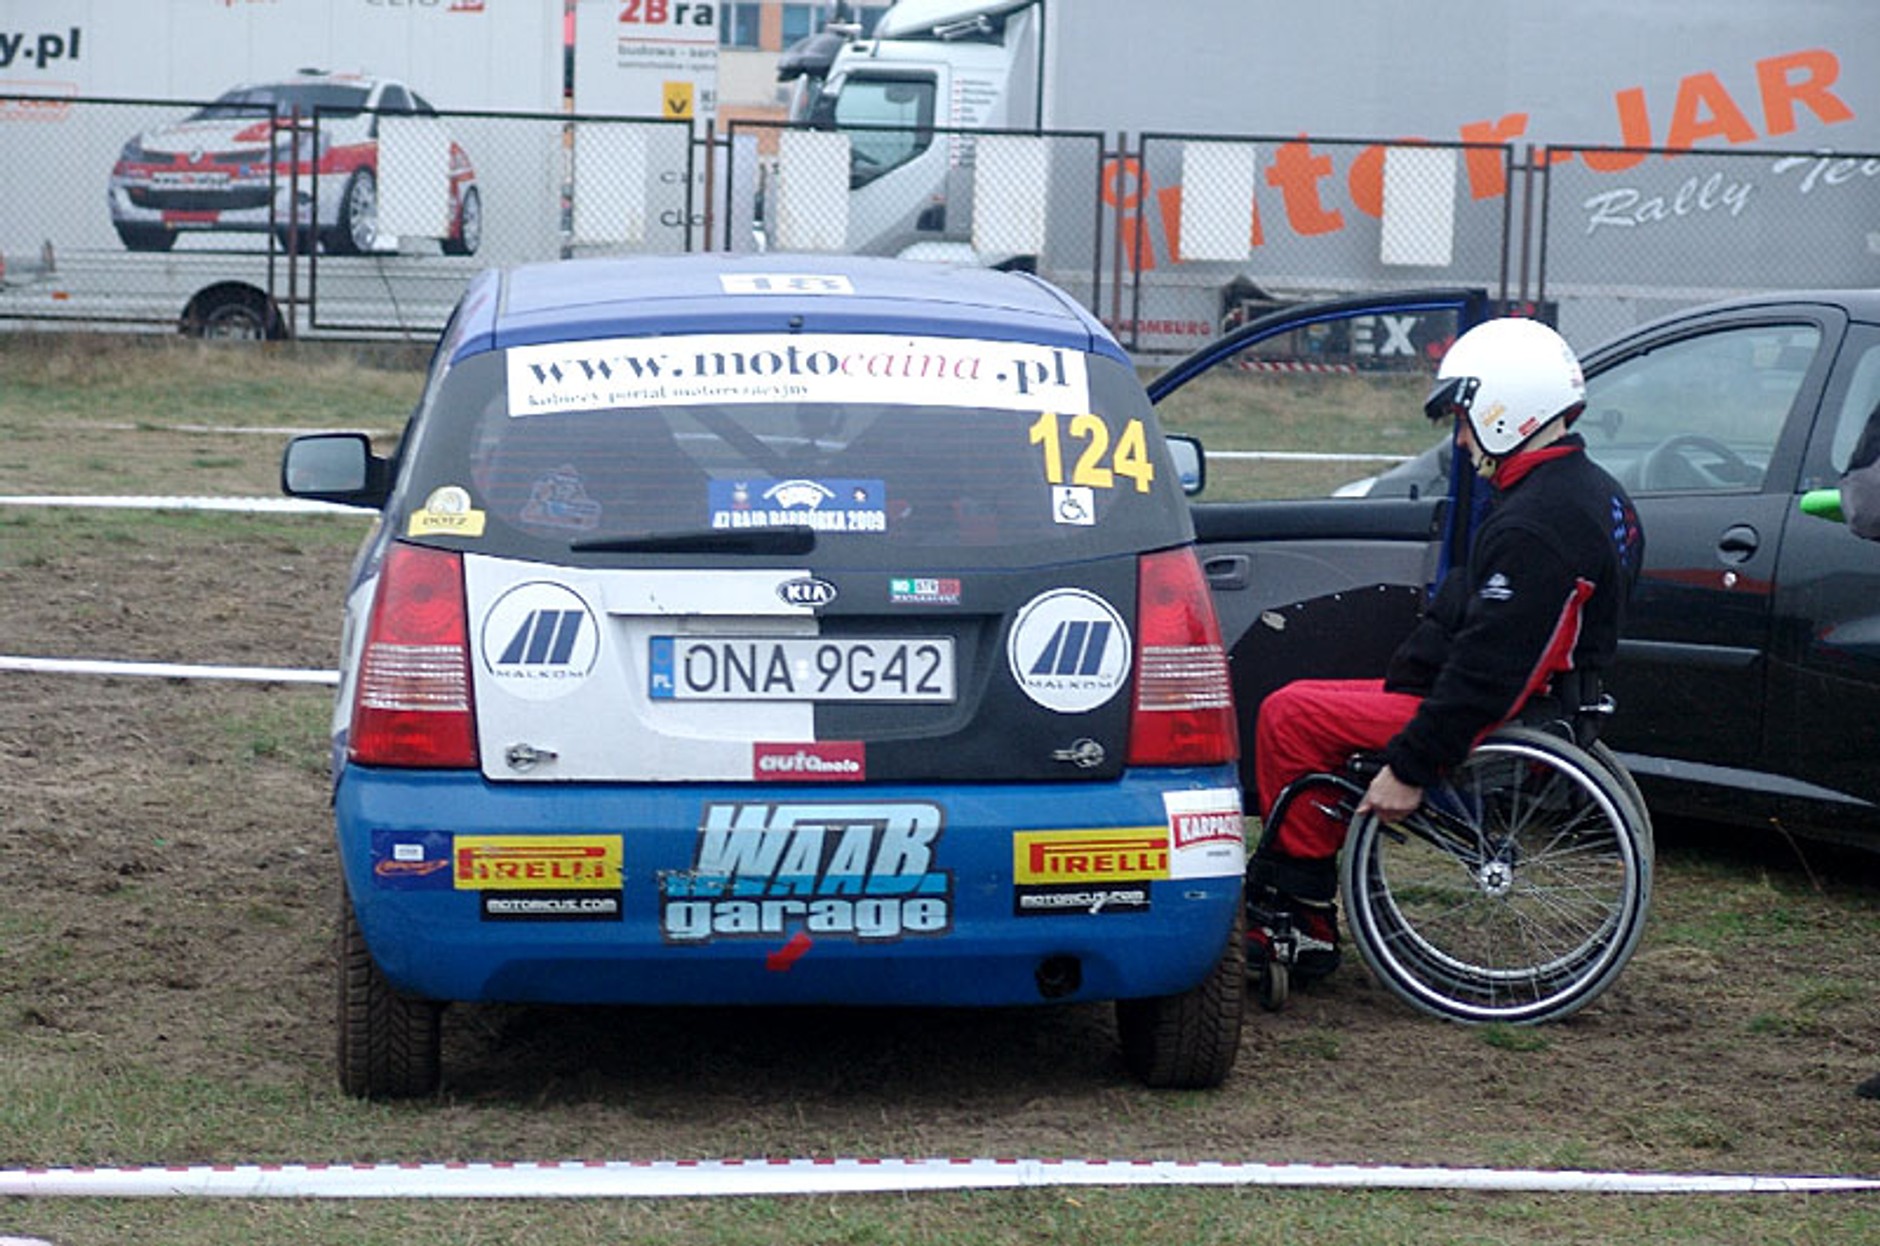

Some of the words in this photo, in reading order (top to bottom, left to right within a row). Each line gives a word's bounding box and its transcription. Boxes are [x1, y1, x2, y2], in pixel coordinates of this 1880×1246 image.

[1583, 171, 1752, 234] Rally
[1028, 412, 1156, 494] 124
[847, 510, 887, 531] 2009
[786, 584, 829, 602] KIA
[652, 674, 673, 689] PL
[684, 643, 795, 693] ONA
[815, 643, 942, 693] 9G42
[1029, 838, 1169, 875] PIRELLI
[665, 897, 949, 941] garage
